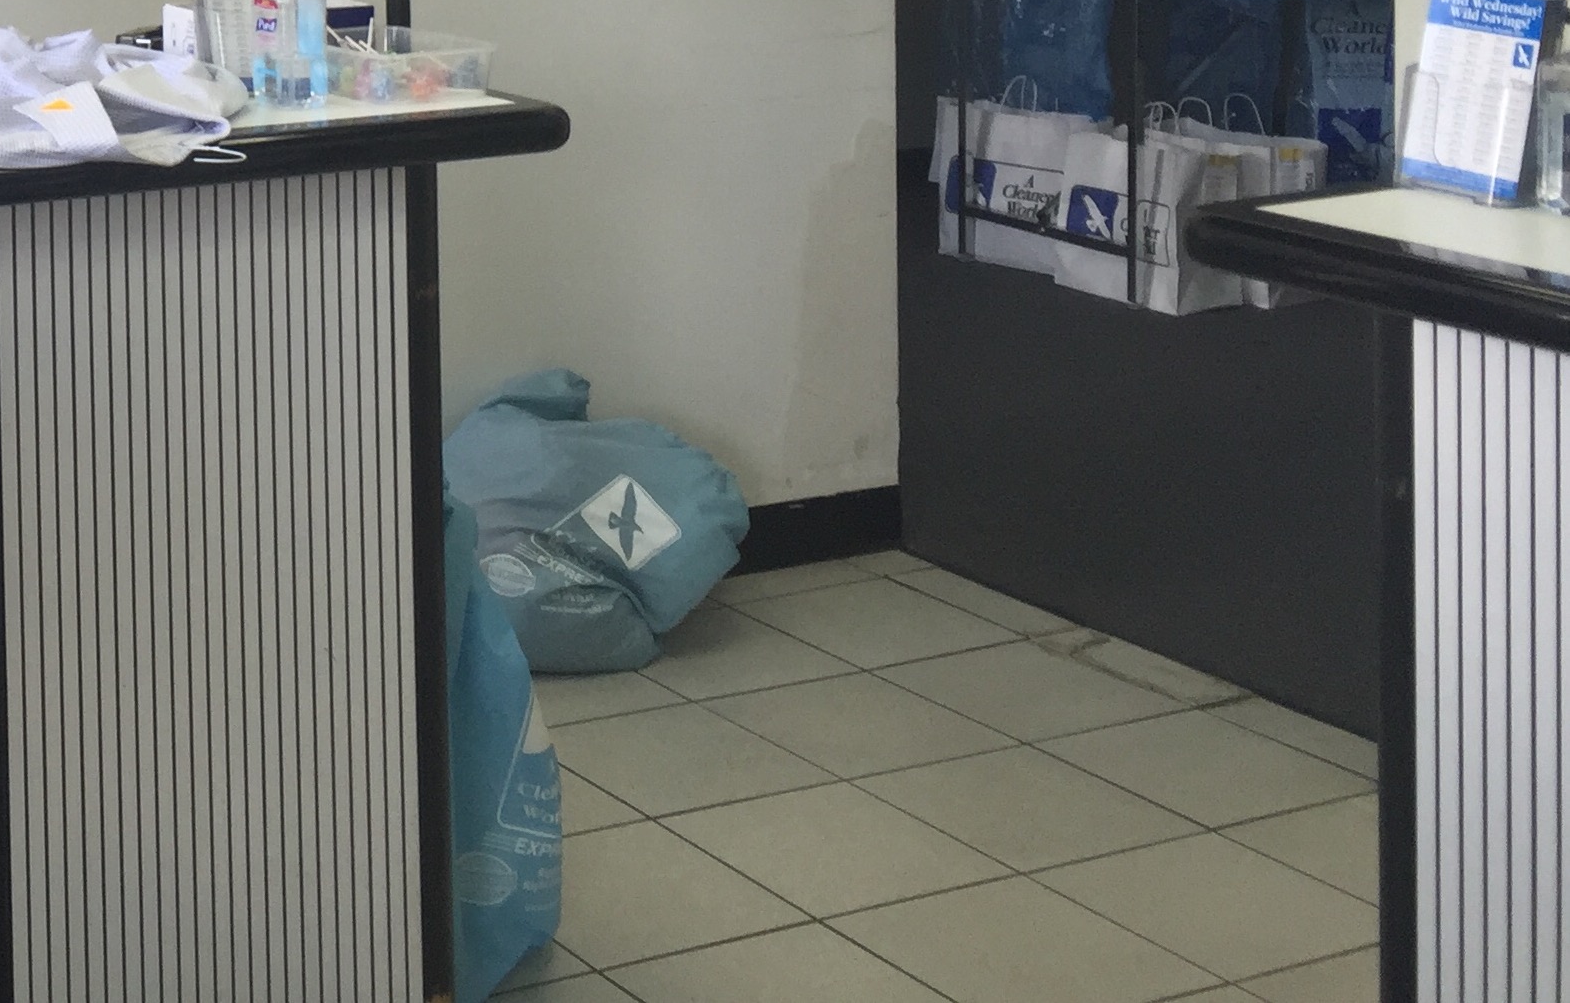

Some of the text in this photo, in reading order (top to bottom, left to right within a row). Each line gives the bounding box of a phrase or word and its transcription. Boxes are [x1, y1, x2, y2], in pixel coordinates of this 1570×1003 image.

[1450, 6, 1480, 22] Wild
[1481, 12, 1532, 31] Savings!
[1022, 174, 1035, 189] A
